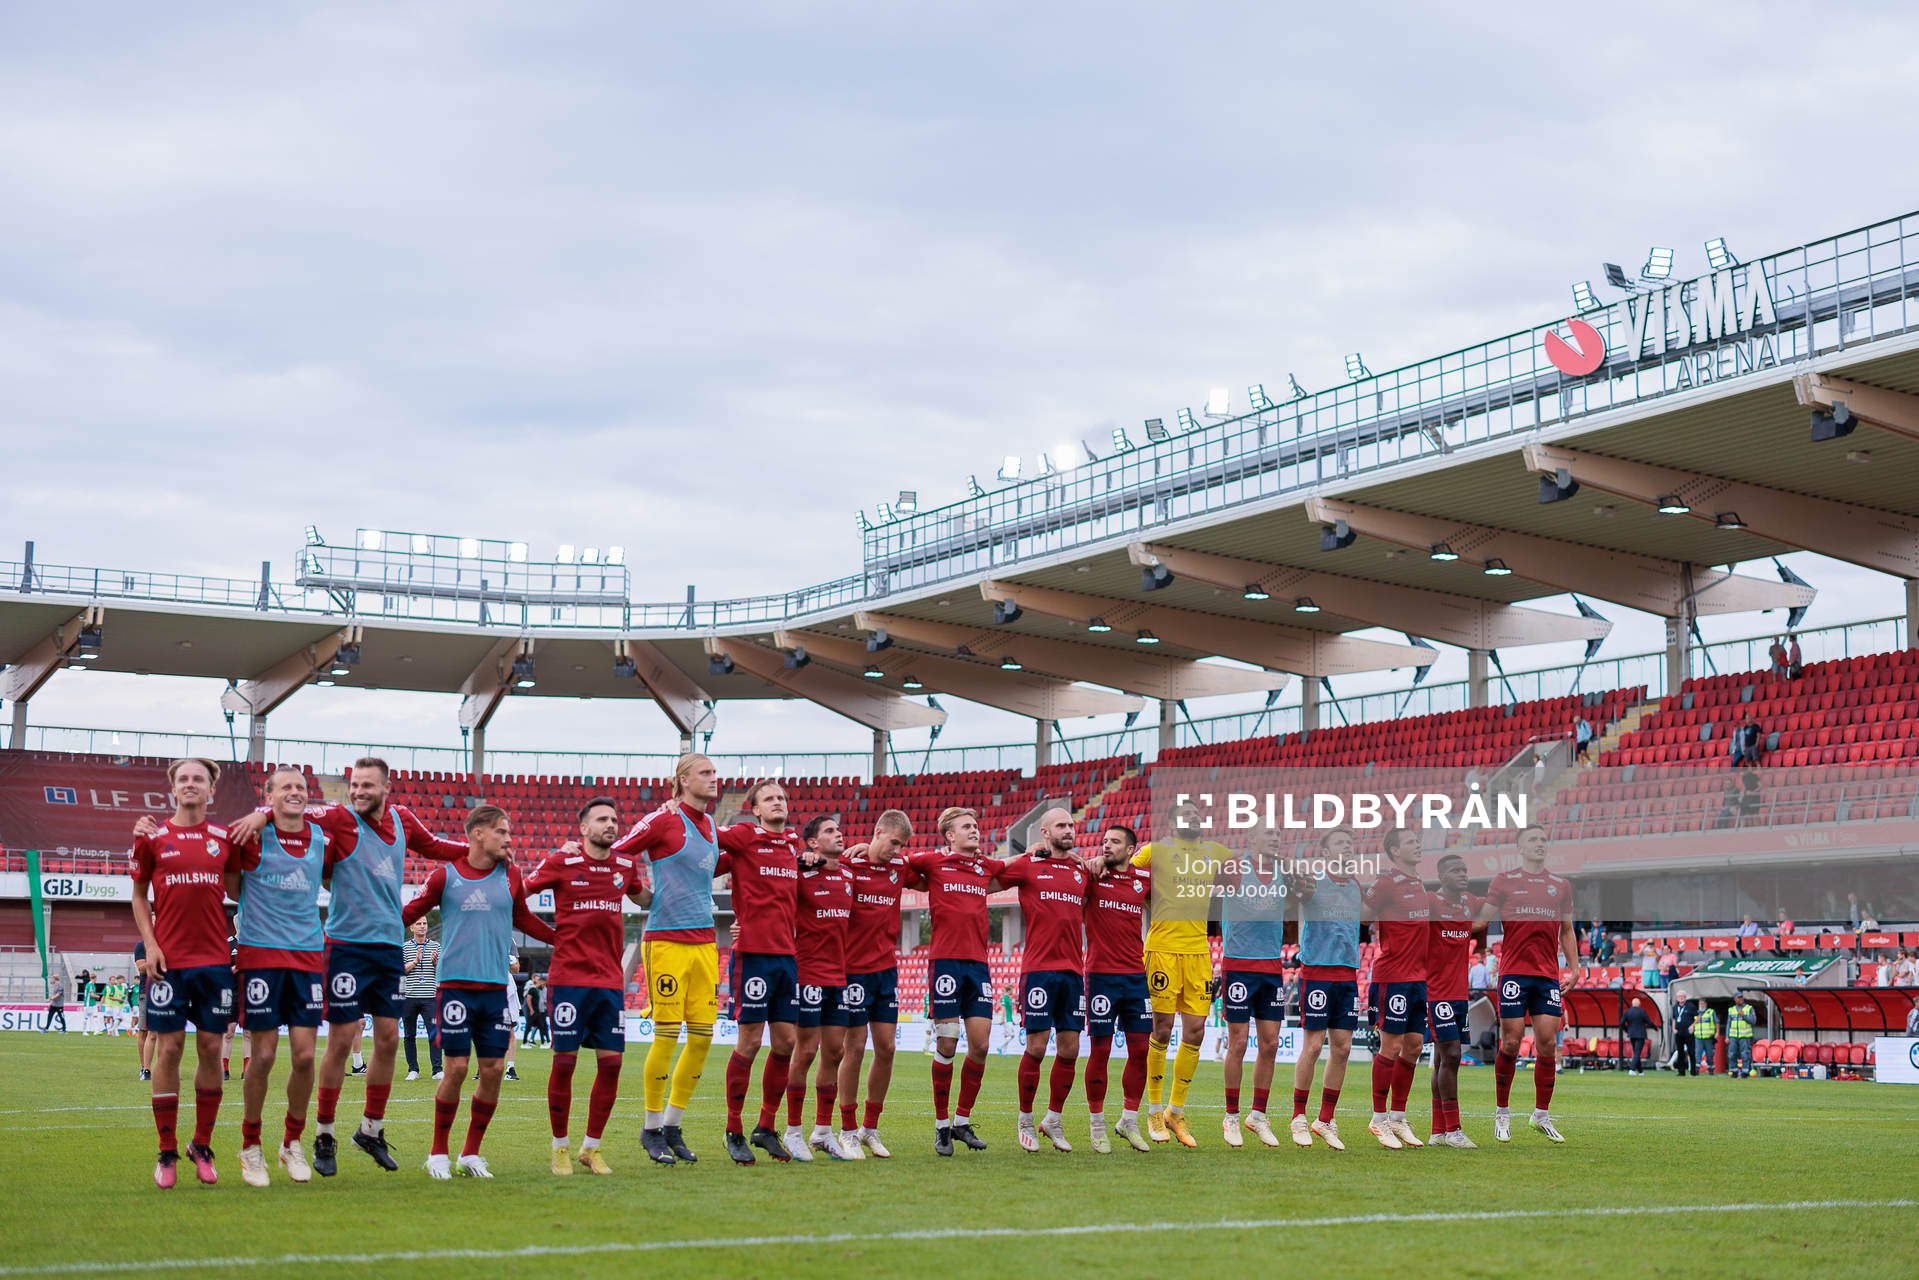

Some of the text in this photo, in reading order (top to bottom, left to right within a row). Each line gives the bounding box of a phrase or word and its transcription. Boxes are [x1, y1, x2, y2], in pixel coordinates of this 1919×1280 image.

[1617, 259, 1777, 361] VISMA
[1676, 334, 1781, 391] ARENA
[90, 789, 128, 807] LF
[165, 872, 219, 886] EMILSHUS
[760, 866, 798, 880] EMILSHUS
[43, 878, 119, 897] GBJ bygg.
[943, 883, 987, 897] EMILSHUS
[573, 900, 620, 913] EMILSHUS
[1099, 900, 1142, 914] EMILSHUS
[1516, 906, 1556, 918] EMILSHUS
[1730, 960, 1806, 972] SUPERETTAN
